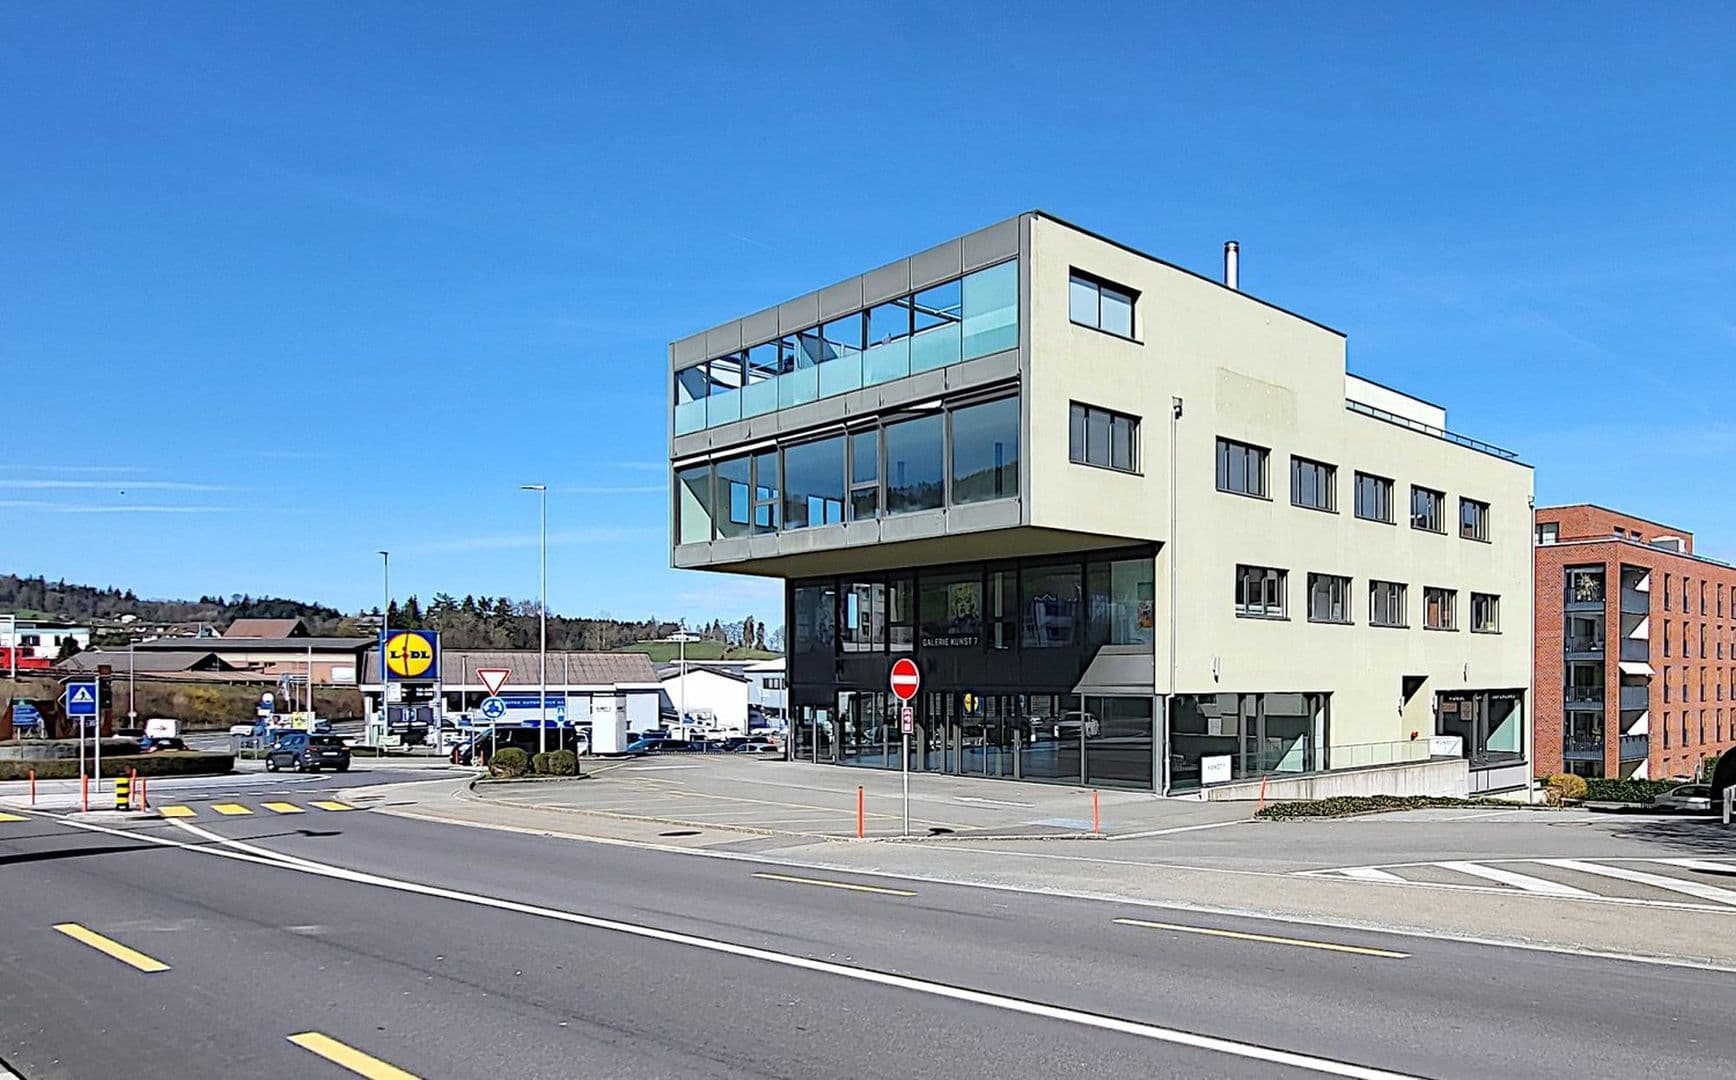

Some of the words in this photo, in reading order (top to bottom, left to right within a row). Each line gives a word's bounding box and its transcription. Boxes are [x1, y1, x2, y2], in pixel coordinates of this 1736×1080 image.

[922, 637, 949, 647] GALERIE
[950, 636, 972, 646] KUNST
[390, 646, 431, 660] LIDL
